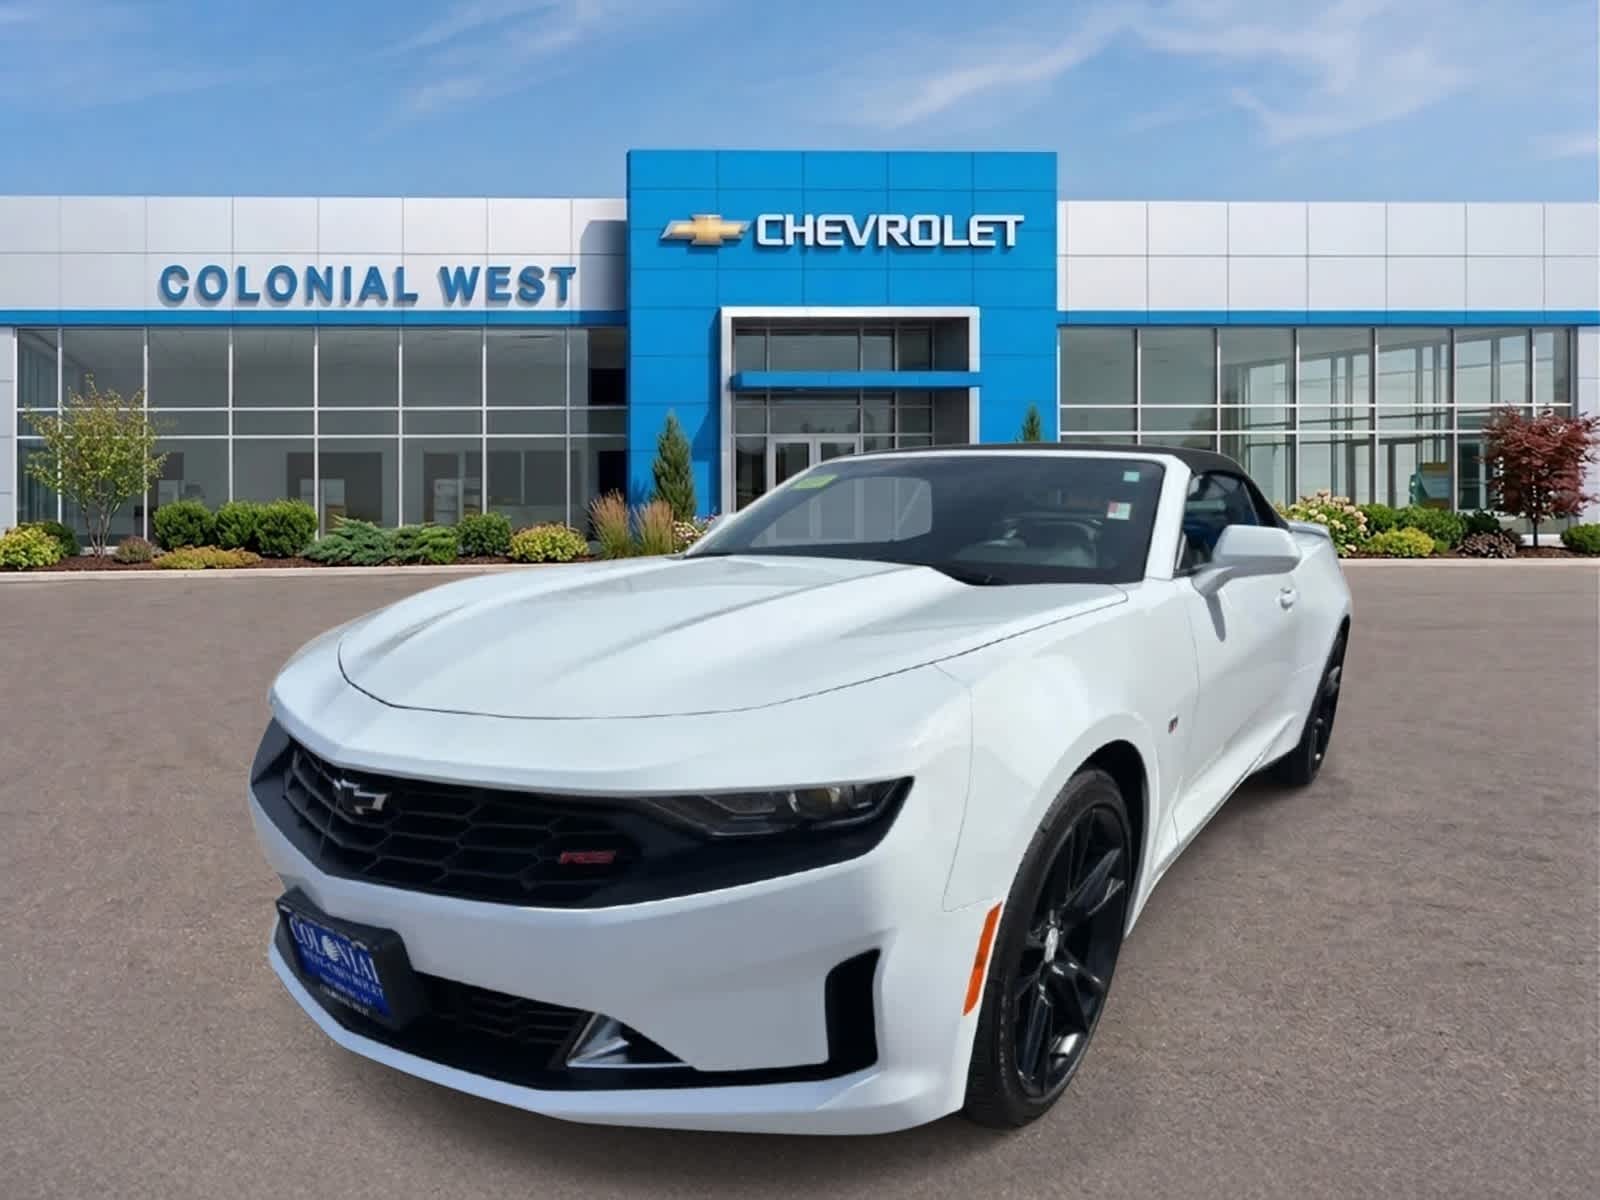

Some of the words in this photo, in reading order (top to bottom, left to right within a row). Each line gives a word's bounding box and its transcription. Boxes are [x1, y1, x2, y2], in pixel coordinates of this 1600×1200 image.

[756, 213, 1024, 247] CHEVROLET
[160, 264, 418, 304] COLONIAL
[438, 265, 577, 304] WEST
